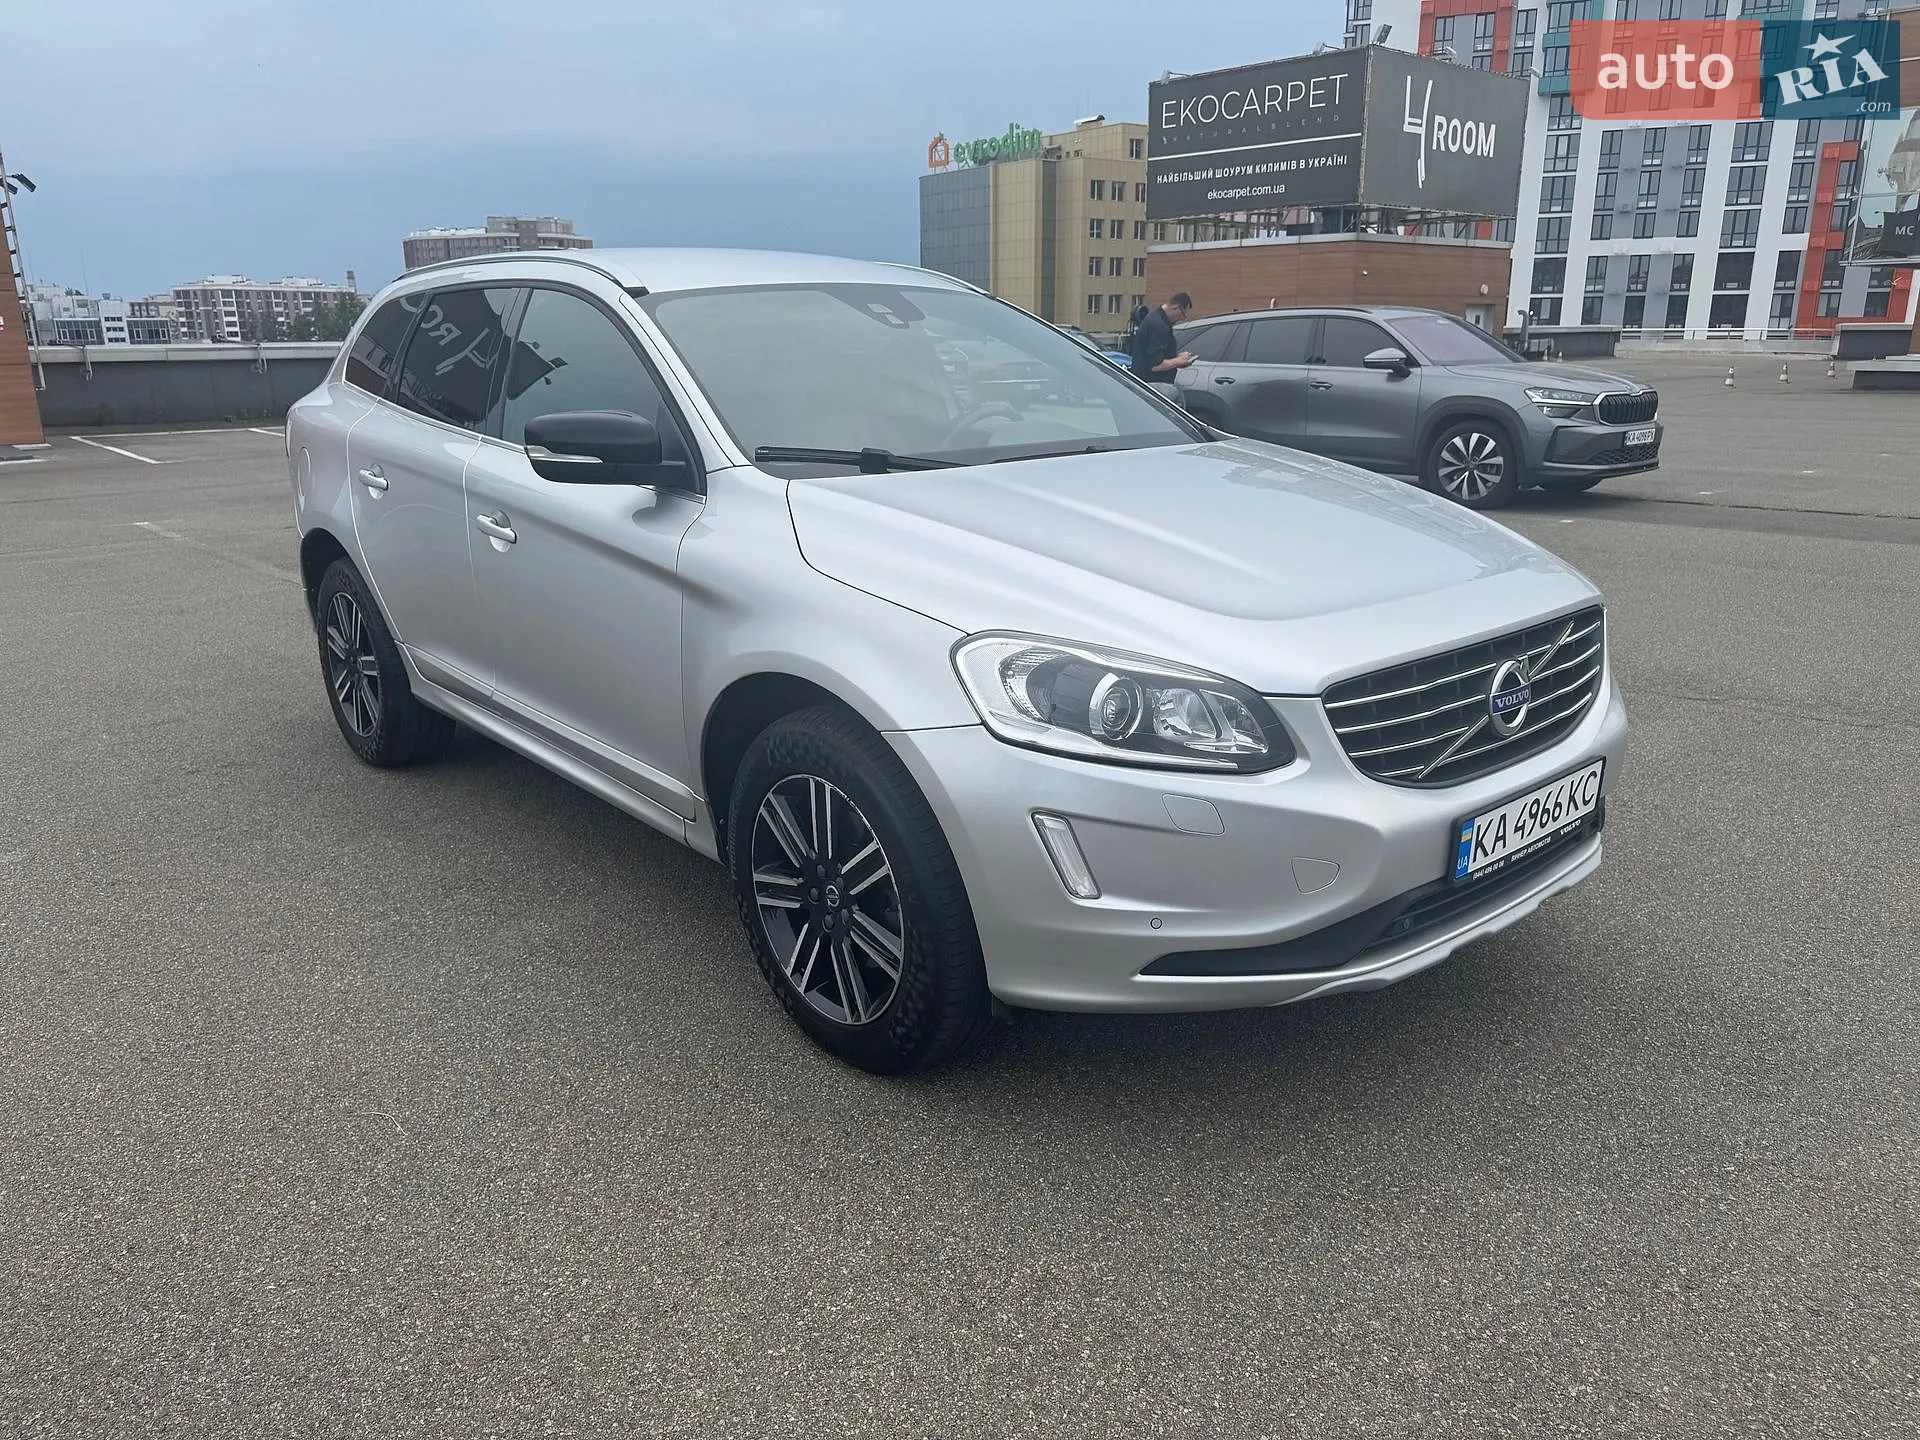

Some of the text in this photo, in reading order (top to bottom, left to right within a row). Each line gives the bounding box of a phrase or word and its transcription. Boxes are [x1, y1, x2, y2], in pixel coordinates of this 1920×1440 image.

[1162, 73, 1349, 129] EKOCARPET
[1157, 153, 1348, 184] НАЙБІЛЬШИЙ ШОУРУМ КИЛИМІВ В УКРАЇНІ
[1207, 183, 1286, 201] ekocarpet.com.ua
[1495, 688, 1529, 708] VOLVO
[1472, 812, 1507, 863] KA
[1457, 855, 1468, 870] UA
